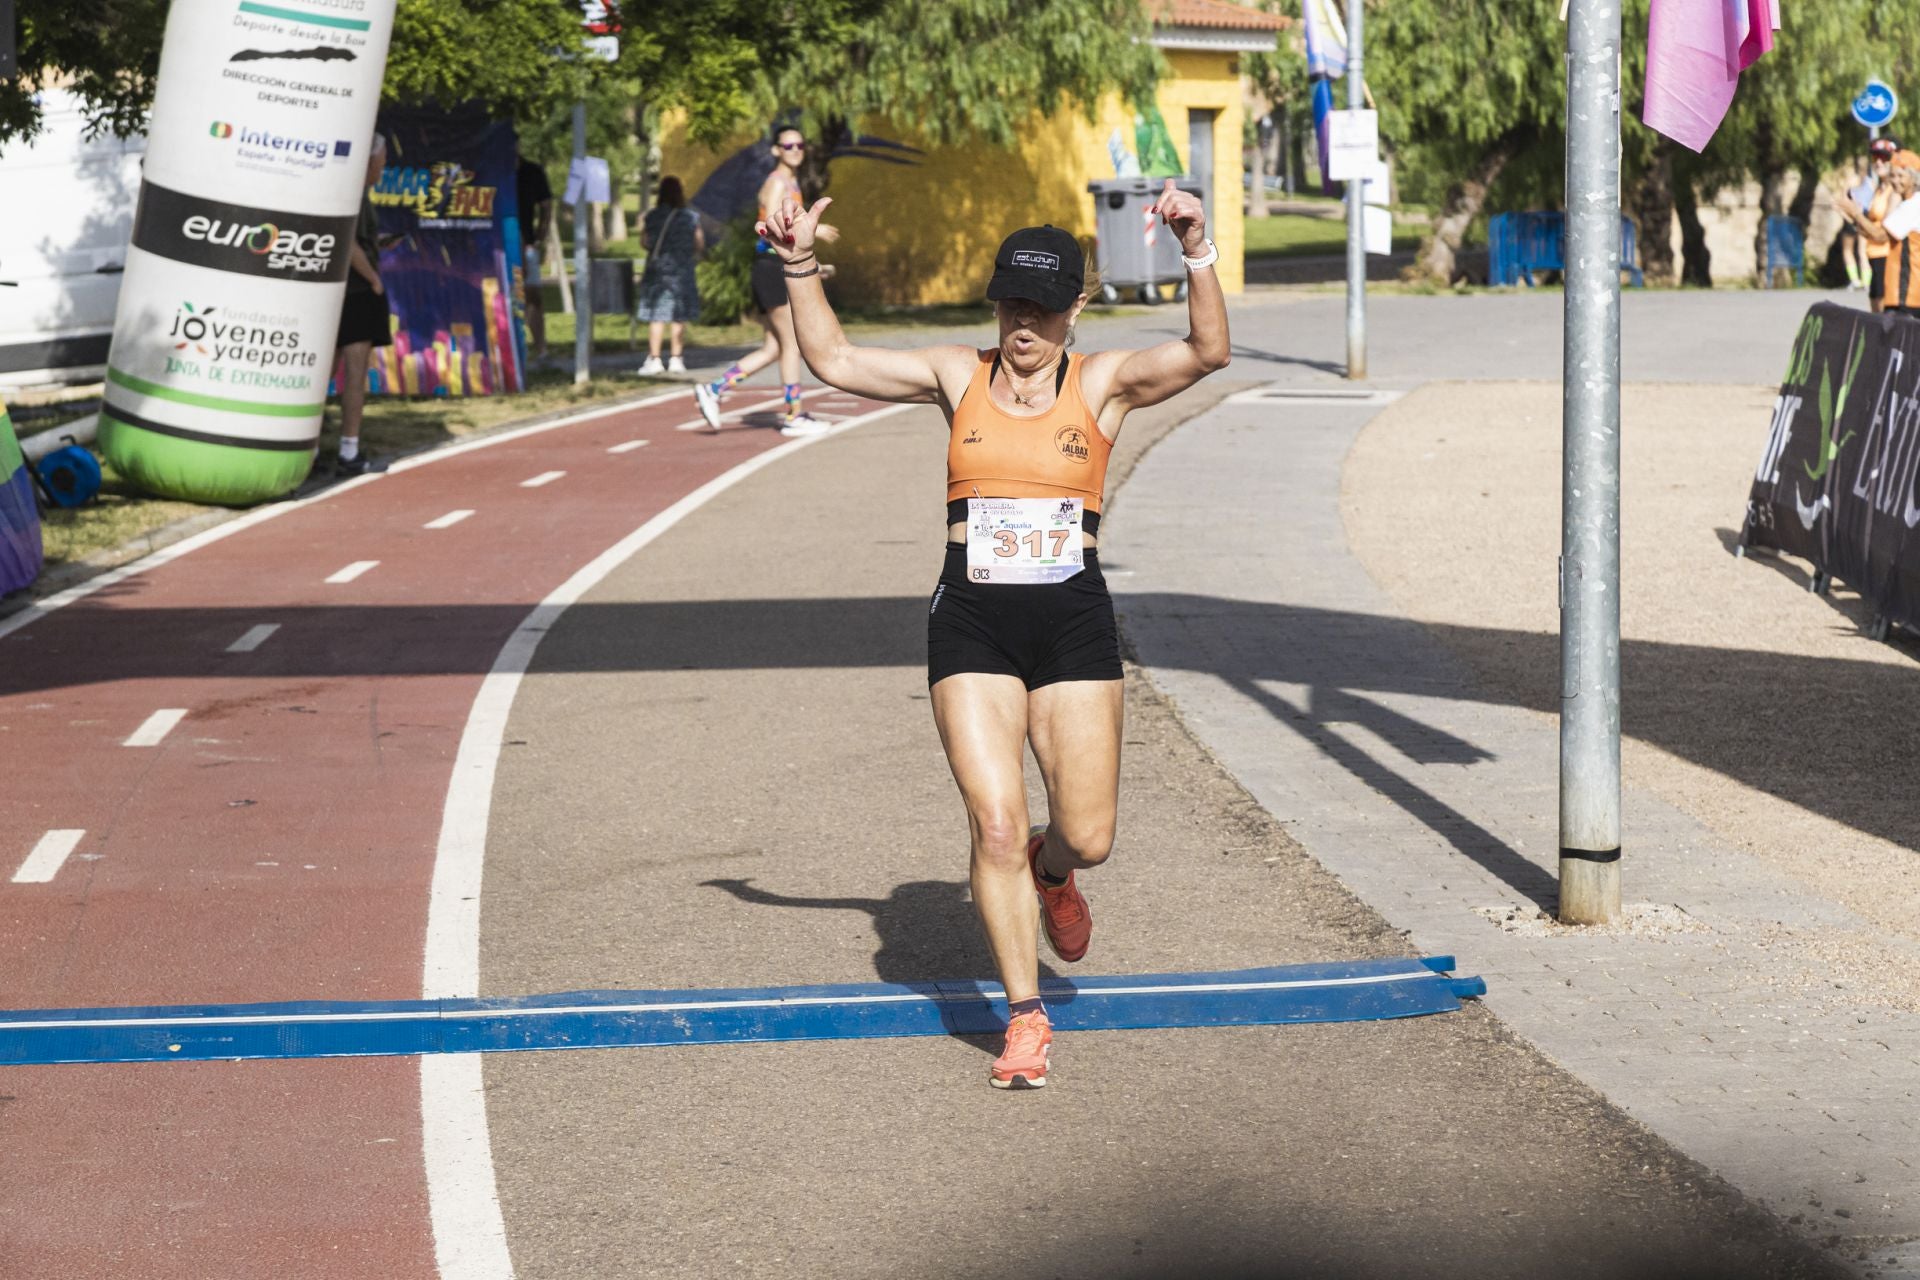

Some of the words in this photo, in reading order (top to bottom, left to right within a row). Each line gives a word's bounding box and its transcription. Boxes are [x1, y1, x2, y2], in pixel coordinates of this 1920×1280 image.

[233, 14, 284, 34] Deporte
[289, 26, 327, 42] desde
[257, 91, 320, 109] DEPORTES
[289, 81, 338, 97] GENERAL
[240, 125, 328, 158] Interreg
[182, 215, 336, 257] euroace
[267, 254, 331, 273] SPORT
[165, 356, 201, 376] JUNTA
[208, 366, 224, 381] DE
[231, 370, 312, 390] EXTREMADURA
[1004, 521, 1032, 530] aqualia
[993, 529, 1070, 558] 317
[973, 568, 990, 580] 5K
